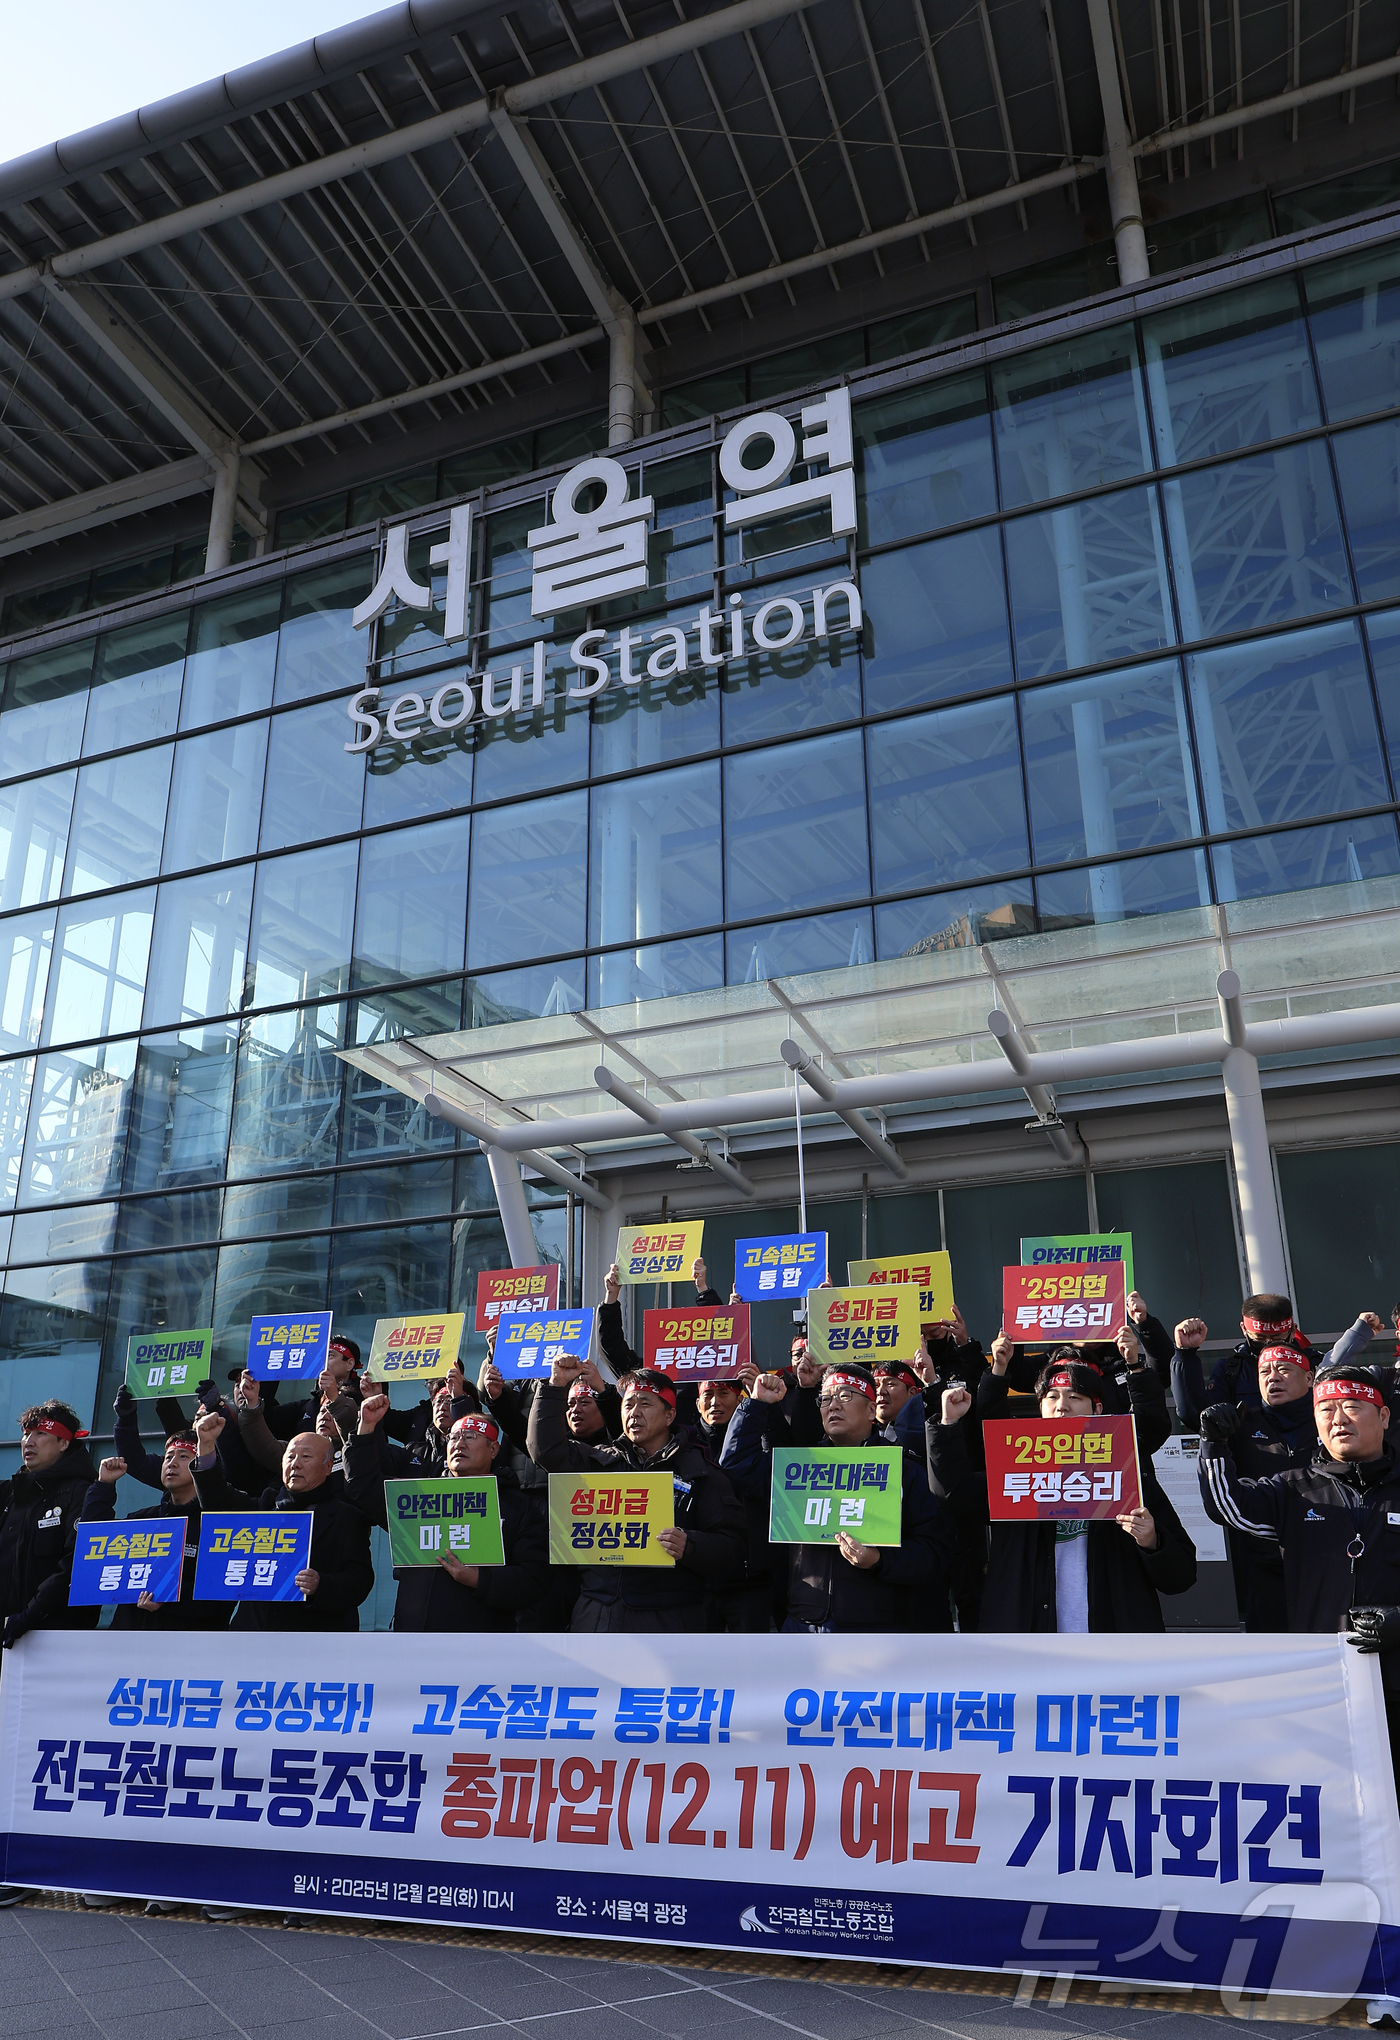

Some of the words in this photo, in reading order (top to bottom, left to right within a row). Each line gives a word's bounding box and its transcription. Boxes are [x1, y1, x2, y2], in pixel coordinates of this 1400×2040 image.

[352, 386, 859, 644] 서울역
[344, 640, 546, 755] Seoul
[569, 581, 864, 698] Station
[631, 1233, 687, 1254] 성과급
[743, 1243, 816, 1268] 고속철도
[629, 1255, 684, 1275] 정상화
[489, 1275, 547, 1297] '25임협
[1020, 1275, 1108, 1299] '25임협
[827, 1297, 898, 1323] 성과급
[1015, 1302, 1113, 1330] 투쟁승리
[256, 1323, 321, 1346] 고속철도
[387, 1325, 445, 1348] 성과급
[505, 1319, 583, 1344] 고속철도
[659, 1317, 734, 1341] '25임협
[827, 1325, 899, 1350] 정상화
[136, 1340, 205, 1364] 안전대책
[383, 1348, 442, 1371] 정상화
[654, 1344, 739, 1370] 투쟁승리
[1316, 1381, 1337, 1398] 단결
[1351, 1382, 1375, 1399] 투쟁
[464, 1418, 488, 1433] 투쟁
[1005, 1433, 1114, 1464] '25임협
[784, 1463, 890, 1492] 안전대책
[1003, 1470, 1123, 1504] 투쟁승리
[397, 1492, 488, 1519] 안전대책
[569, 1488, 650, 1516] 성과급
[83, 1532, 173, 1560] 고속철도
[208, 1527, 299, 1554] 고속철도
[570, 1522, 651, 1549] 정상화
[106, 1677, 224, 1728] 성과급
[234, 1680, 375, 1735] 정상화!
[412, 1684, 600, 1740] 고속철도
[613, 1686, 736, 1745] 통합!
[783, 1688, 1017, 1755] 안전대책
[1034, 1694, 1181, 1758] 마련!
[31, 1739, 427, 1835] 전국철도노동조합
[440, 1751, 817, 1861] 총파업(12.11)
[839, 1765, 982, 1865] 예고
[1005, 1775, 1326, 1886] 기자회견
[331, 1878, 388, 1901] 2025년
[393, 1882, 423, 1904] 12월
[427, 1886, 478, 1908] 2일(화)
[482, 1890, 514, 1912] 10시
[600, 1899, 649, 1923] 서울역
[653, 1902, 688, 1926] 광장
[768, 1906, 895, 1933] 전국철도노동조합
[784, 1927, 810, 1936] Korean
[811, 1929, 838, 1939] Railway
[873, 1934, 894, 1942] Union
